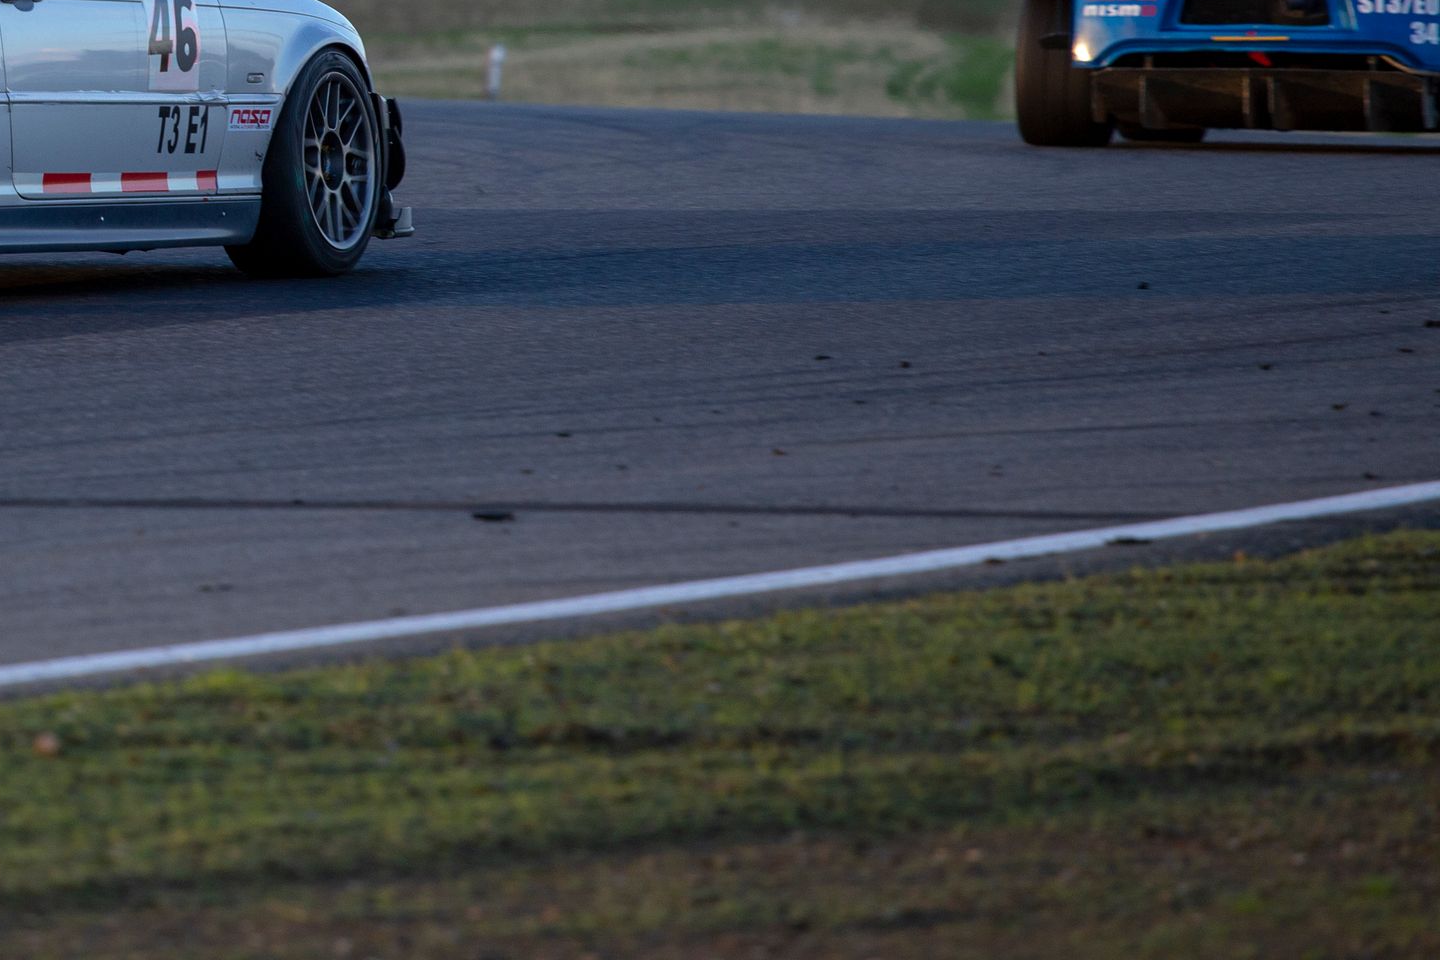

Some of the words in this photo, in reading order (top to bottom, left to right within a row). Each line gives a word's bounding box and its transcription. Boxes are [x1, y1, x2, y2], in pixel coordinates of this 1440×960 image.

[157, 106, 180, 154] T3
[184, 105, 208, 154] E1
[230, 109, 271, 124] nasa
